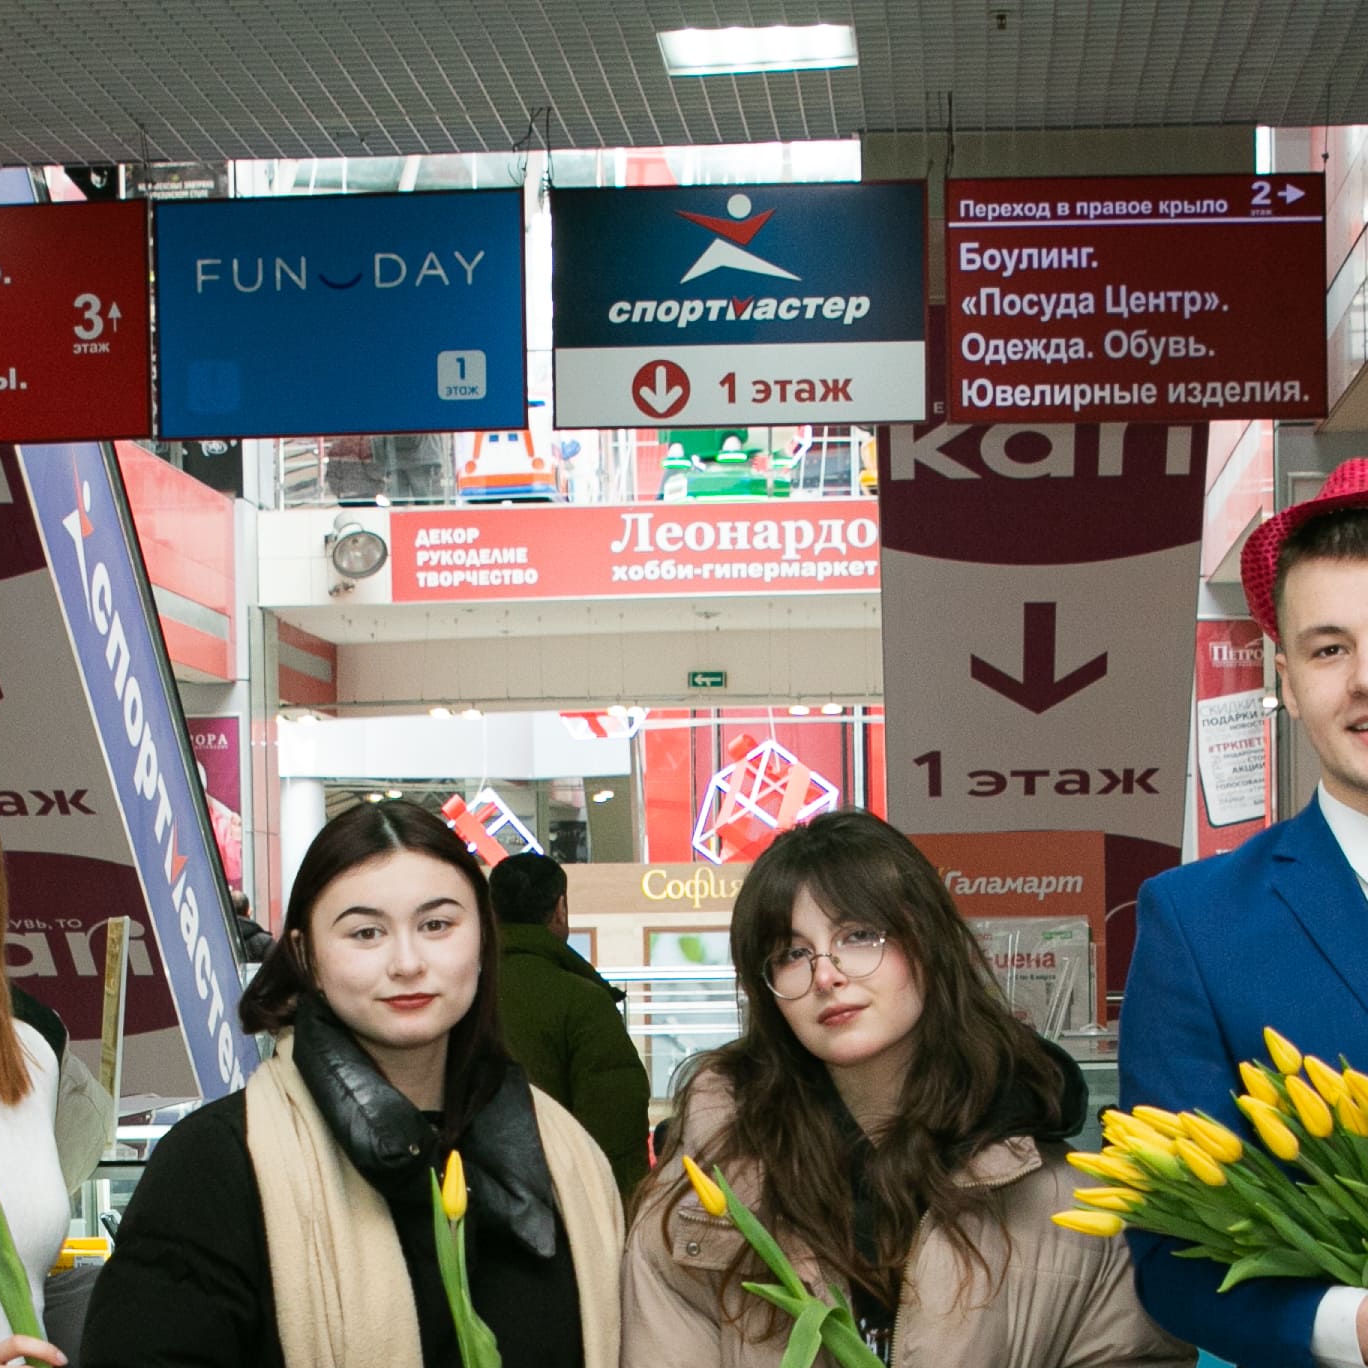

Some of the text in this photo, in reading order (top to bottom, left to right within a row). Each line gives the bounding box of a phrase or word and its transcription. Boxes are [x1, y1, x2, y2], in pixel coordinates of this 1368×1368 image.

[959, 198, 1228, 218] Переход в правое крыло
[1251, 181, 1272, 205] 2
[196, 250, 485, 293] FUN DAY
[959, 242, 1098, 277] Боулинг.
[73, 293, 104, 340] 3
[608, 295, 871, 328] спортмастер
[961, 285, 1229, 322] «Посуда Центр».
[72, 341, 111, 354] этаж
[961, 329, 1215, 365] Одежда. Обувь.
[455, 357, 467, 380] 1
[445, 386, 480, 396] этаж
[719, 372, 853, 404] 1 этаж
[961, 378, 1158, 411] Ювелирные
[1168, 380, 1310, 408] изделия.
[415, 527, 480, 548] ДЕКОР
[611, 513, 878, 561] Леонардо
[416, 548, 529, 567] РУКОДЕЛИЕ
[611, 558, 878, 583] хобби-гипермаркет
[415, 568, 539, 588] ТВОРЧЕСТВО
[1202, 710, 1258, 728] ПОДАРКИ
[913, 750, 1160, 798] 1 этаж
[641, 866, 745, 909] София
[944, 871, 1083, 901] Галамарт
[8, 918, 82, 931] УВЬ, ТО
